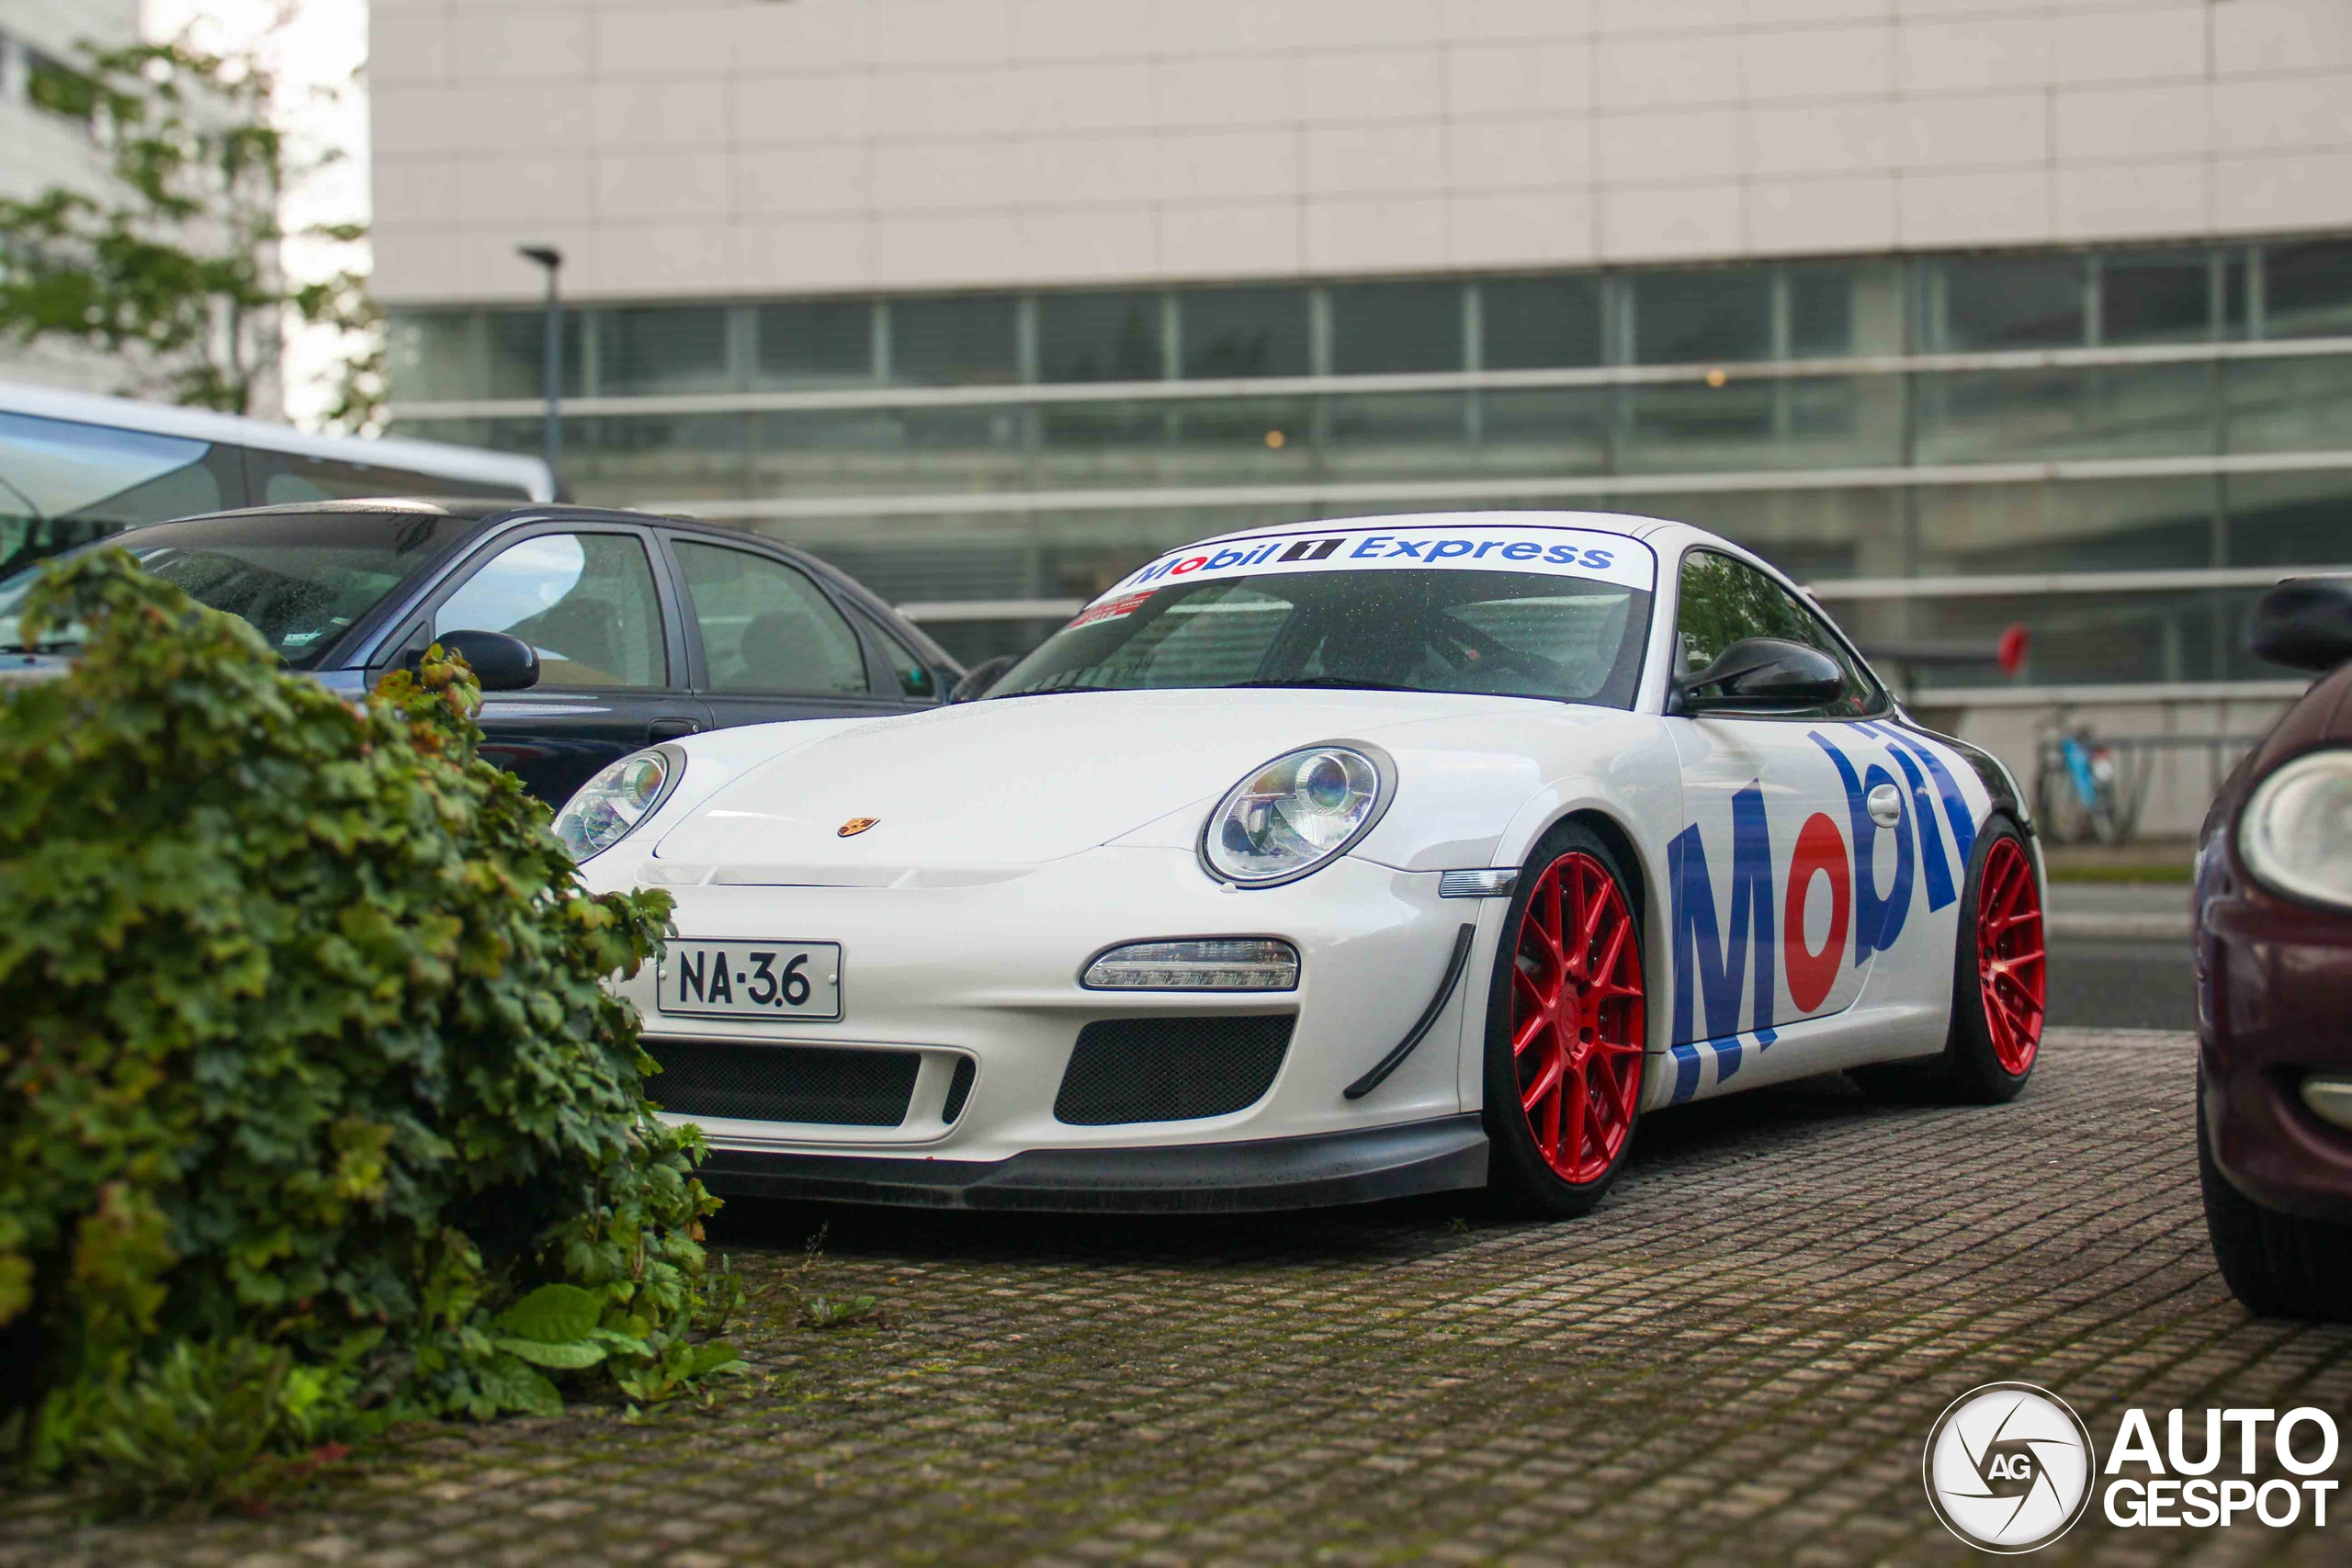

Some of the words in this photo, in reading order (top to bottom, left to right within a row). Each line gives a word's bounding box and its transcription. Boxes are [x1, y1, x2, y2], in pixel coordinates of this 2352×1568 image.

[1125, 544, 1282, 588] Mobil
[1349, 536, 1615, 570] Express
[1667, 720, 1976, 1103] Mobil
